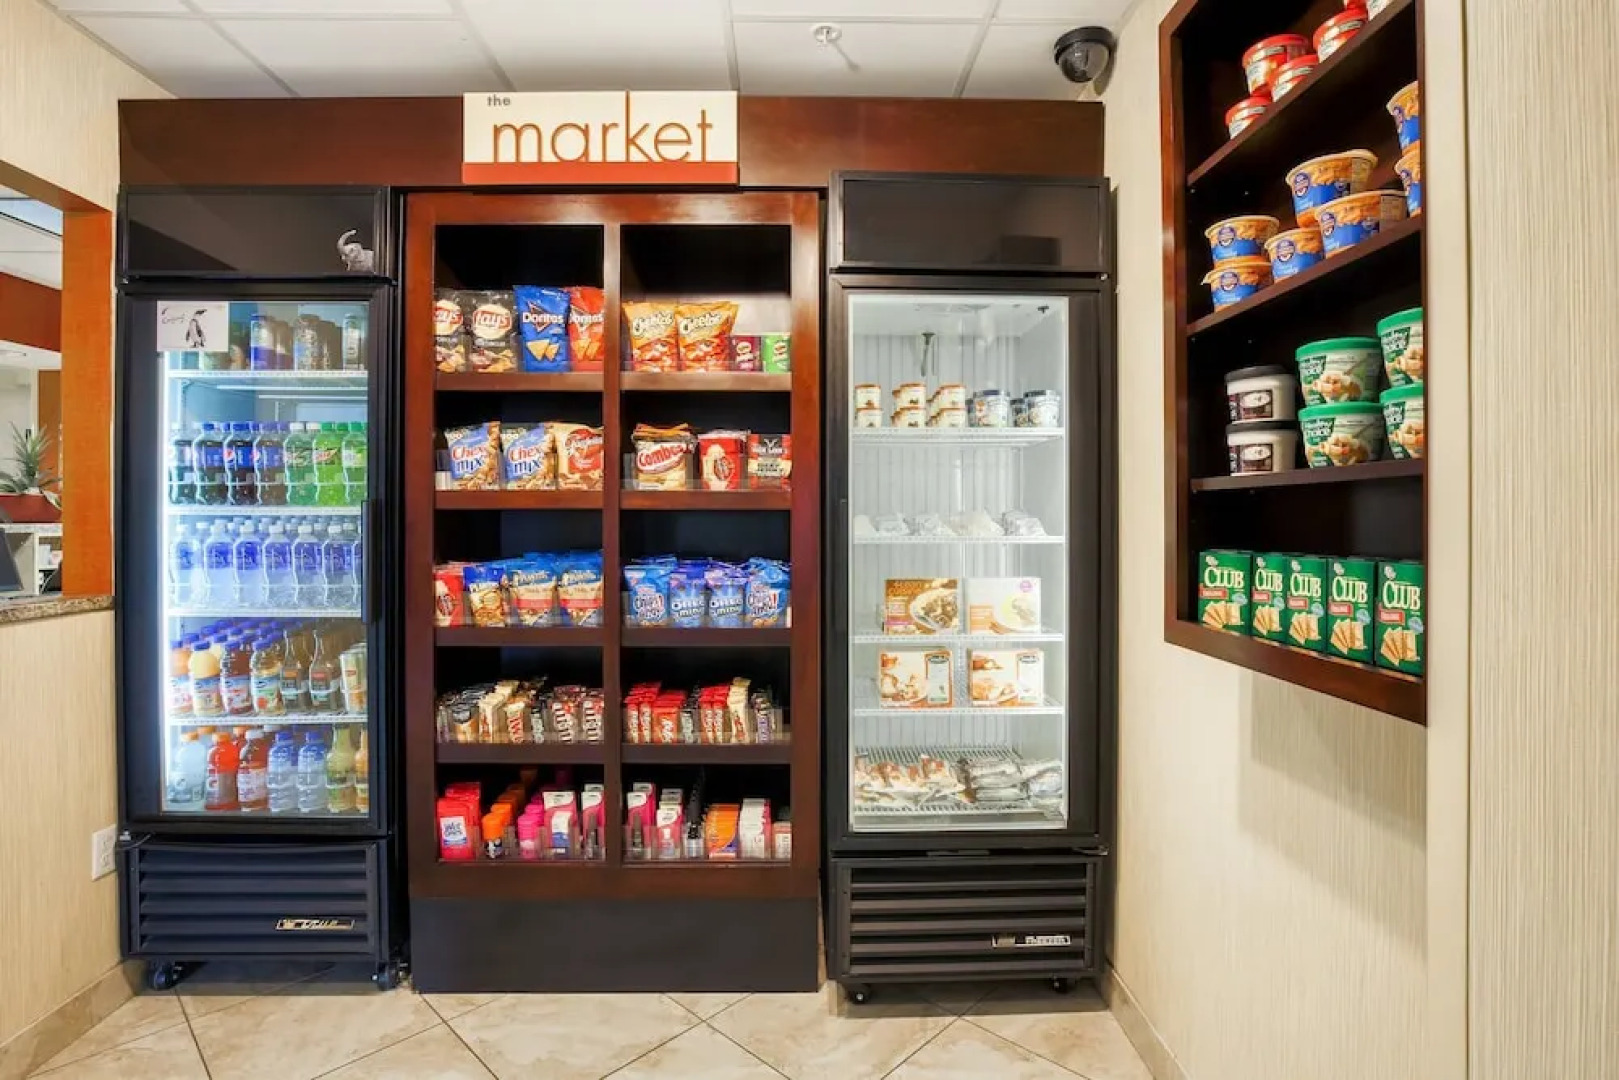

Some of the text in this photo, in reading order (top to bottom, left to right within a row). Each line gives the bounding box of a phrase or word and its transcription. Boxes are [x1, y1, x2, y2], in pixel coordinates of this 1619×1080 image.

[487, 94, 511, 107] the
[493, 90, 713, 163] market
[522, 312, 564, 324] Doritos
[1204, 567, 1244, 589] CLUB
[1255, 568, 1283, 591] CLUB
[1289, 572, 1321, 597] CLUB
[1332, 576, 1368, 603] CLUB
[1383, 580, 1420, 610] CLUB
